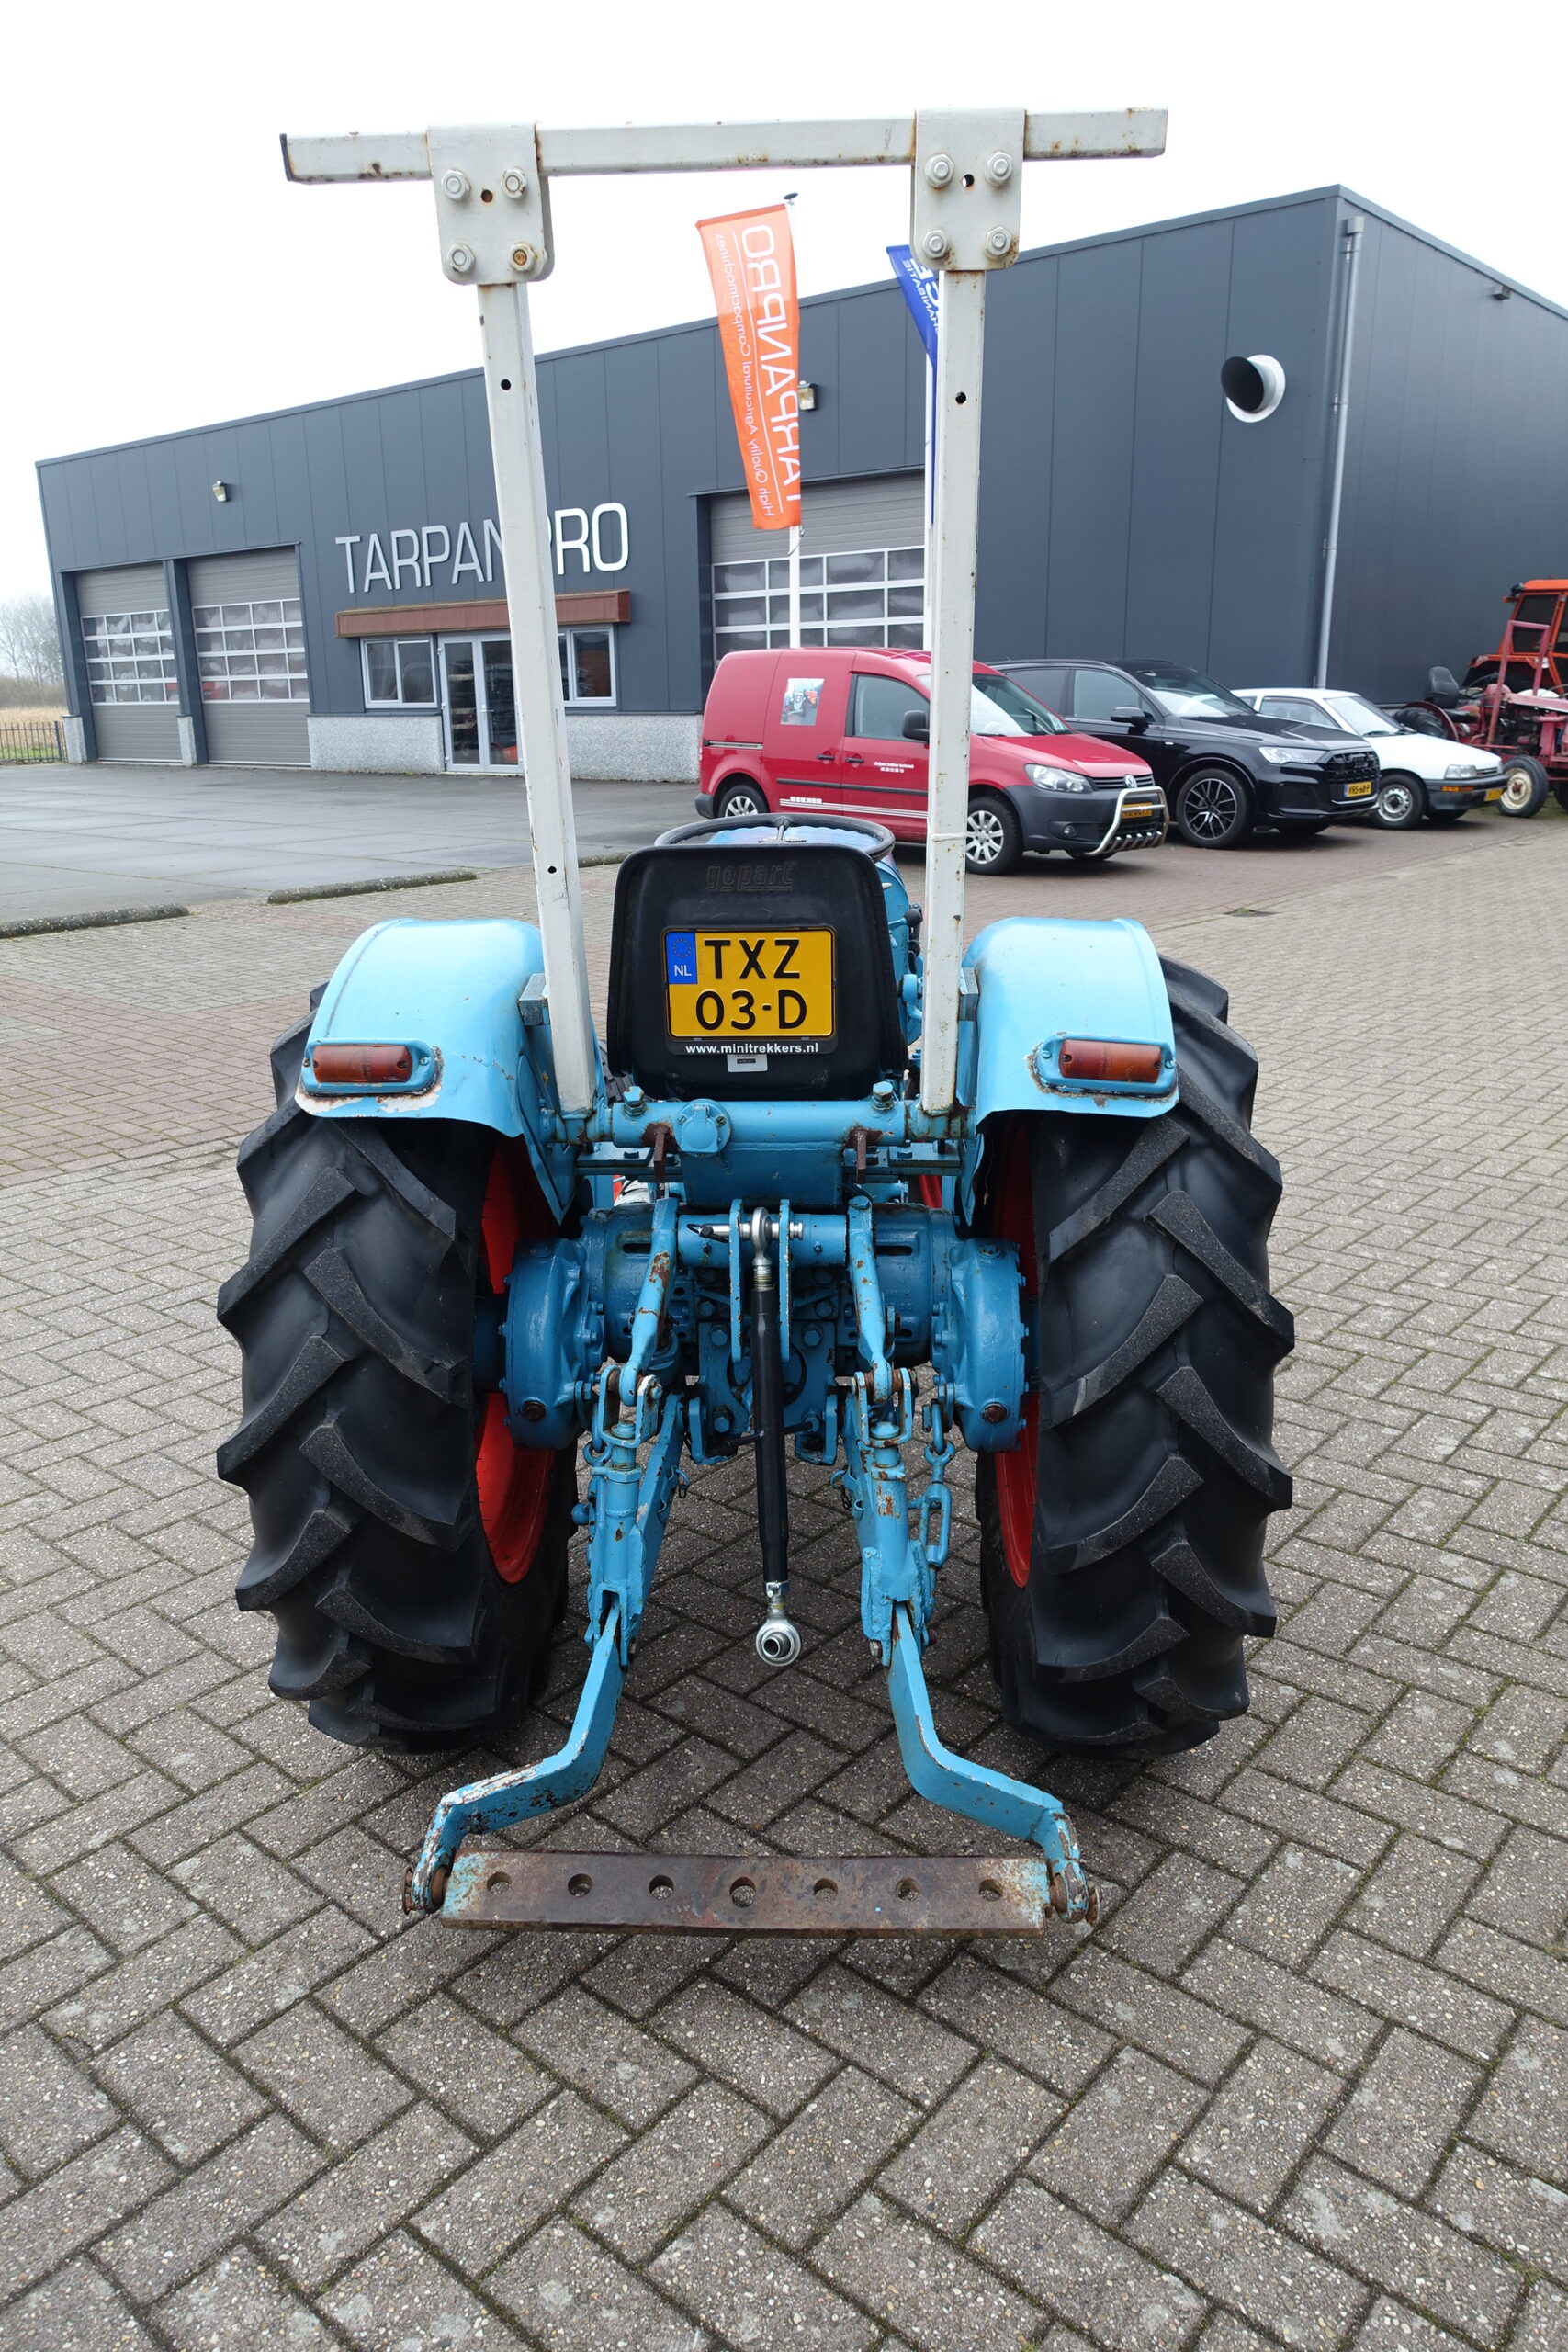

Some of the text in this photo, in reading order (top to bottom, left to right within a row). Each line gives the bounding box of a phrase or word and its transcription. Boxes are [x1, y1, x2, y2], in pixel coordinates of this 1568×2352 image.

[674, 965, 693, 976] NL
[704, 939, 800, 979] TXZ
[695, 989, 807, 1031] 03-D
[685, 1042, 818, 1054] www.minitrekkers.nl
